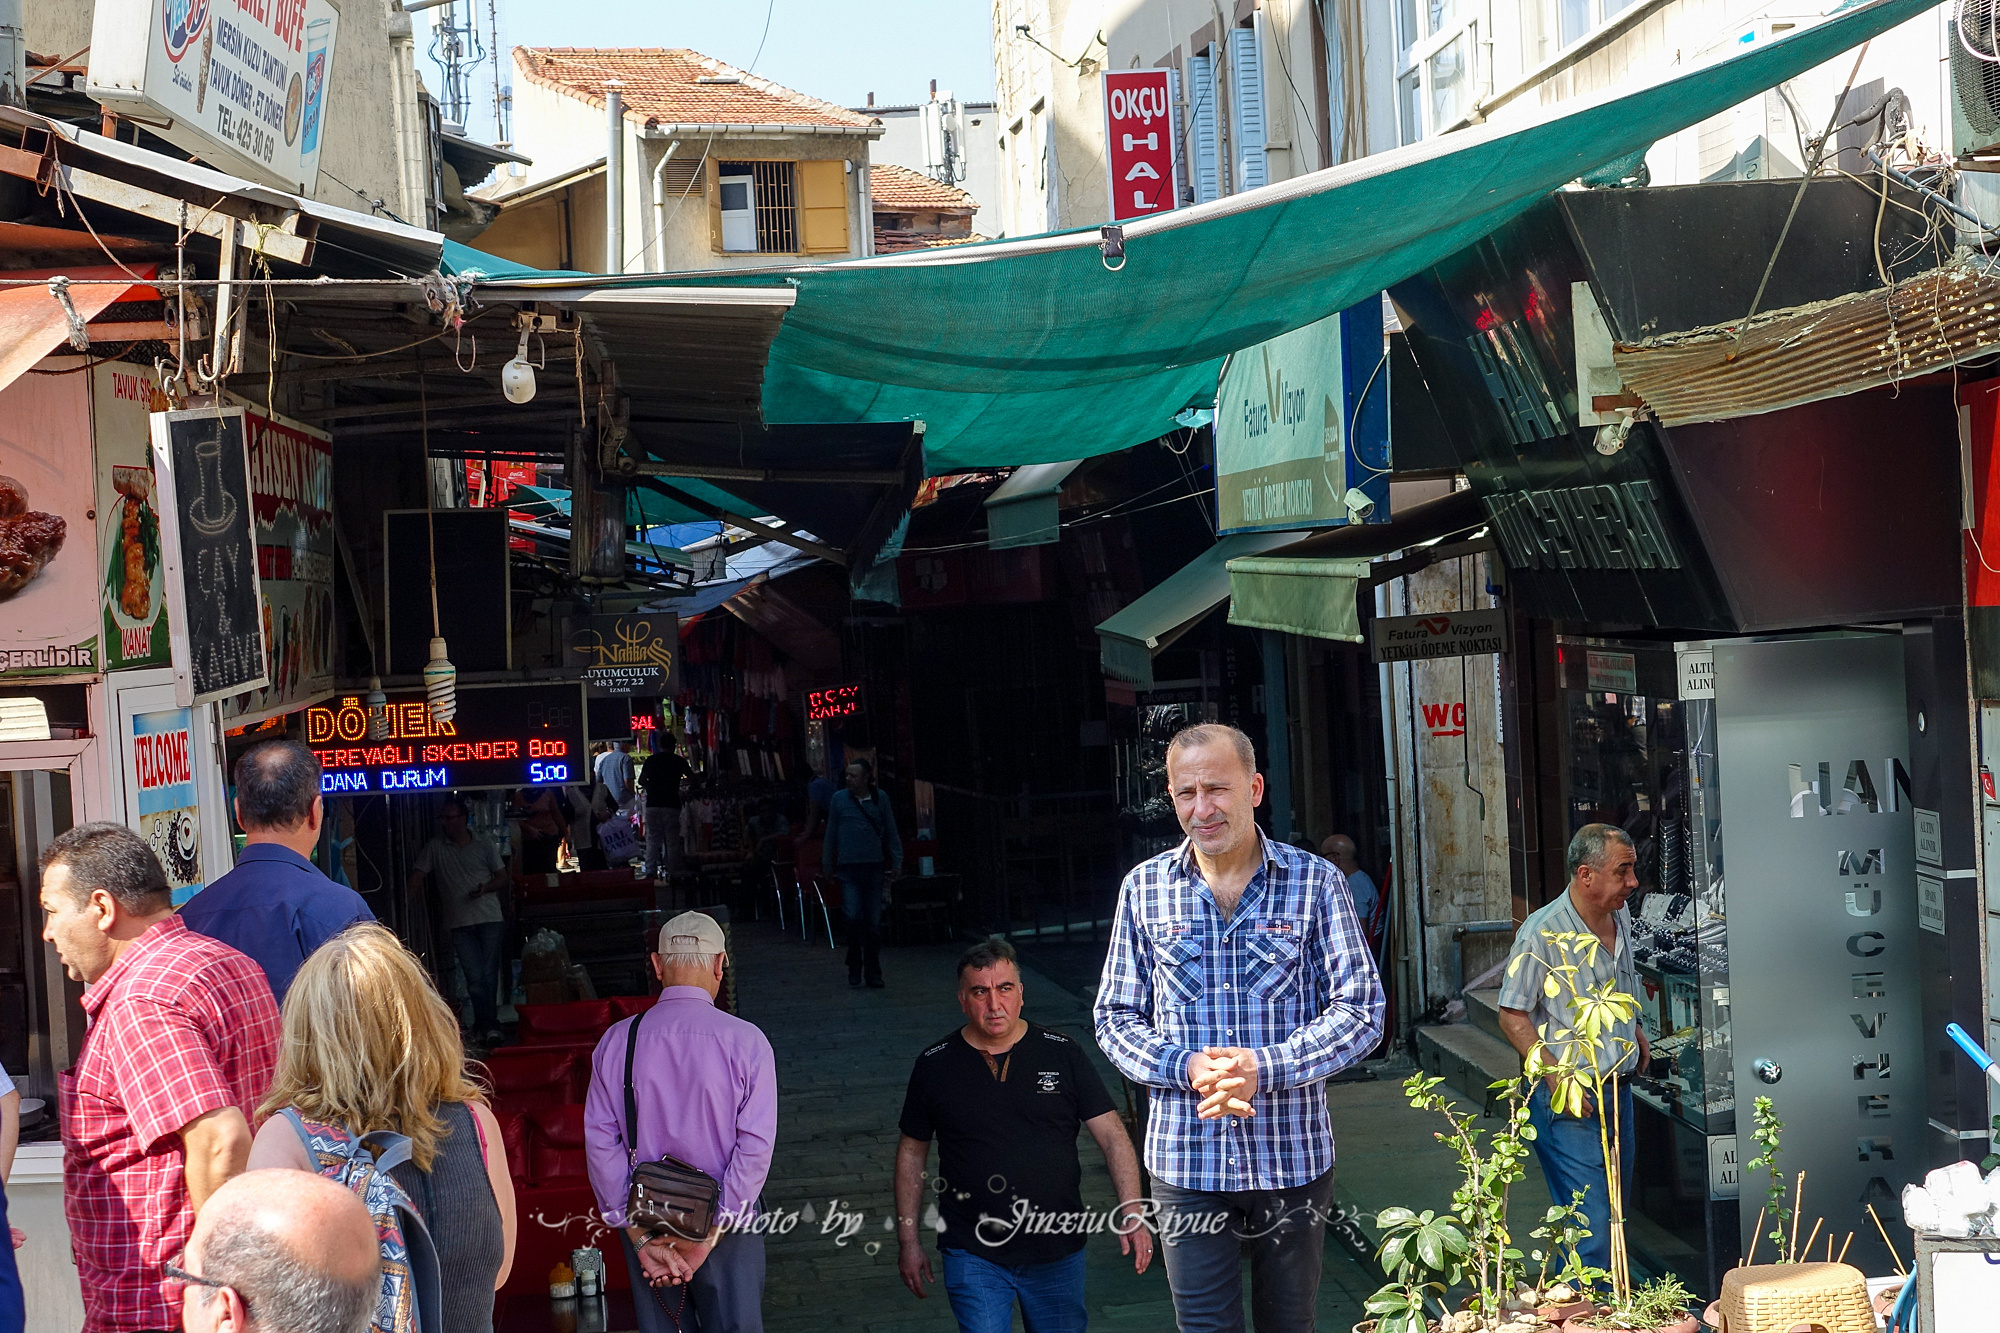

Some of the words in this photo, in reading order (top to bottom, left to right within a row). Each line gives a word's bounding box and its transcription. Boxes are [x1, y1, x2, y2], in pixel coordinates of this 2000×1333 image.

[216, 16, 242, 60] MERSİN
[243, 38, 262, 73] KUZU
[262, 51, 288, 92] TANTUNİ
[210, 58, 232, 98] TAVUK
[231, 70, 253, 112] DÖNER
[255, 90, 265, 118] ET
[263, 93, 284, 132] DÖNER
[1110, 87, 1166, 125] OKÇU
[218, 103, 236, 141] TEL:
[237, 117, 252, 151] 425
[252, 127, 264, 158] 30
[264, 134, 275, 164] 69
[1122, 132, 1160, 209] HAL
[112, 372, 139, 402] TAVUK
[1244, 399, 1268, 440] Fatura
[1281, 381, 1306, 436] Vizyon
[122, 626, 151, 660] KANAT
[1388, 628, 1428, 641] Fatura
[1450, 624, 1493, 637] Vizyon
[1421, 640, 1456, 657] ÖDEME
[1459, 637, 1502, 653] NOKTASI
[580, 667, 659, 679] UYUMCULUK
[593, 679, 614, 687] 483
[616, 678, 629, 686] 77
[631, 677, 645, 686] 22
[1422, 702, 1465, 728] WC
[528, 739, 566, 758] 8.00
[321, 771, 368, 792] DANA
[381, 767, 447, 789] DÜRÜM
[529, 762, 568, 782] 5.00
[1788, 757, 1912, 818] HAN
[1920, 821, 1935, 834] ALTIN
